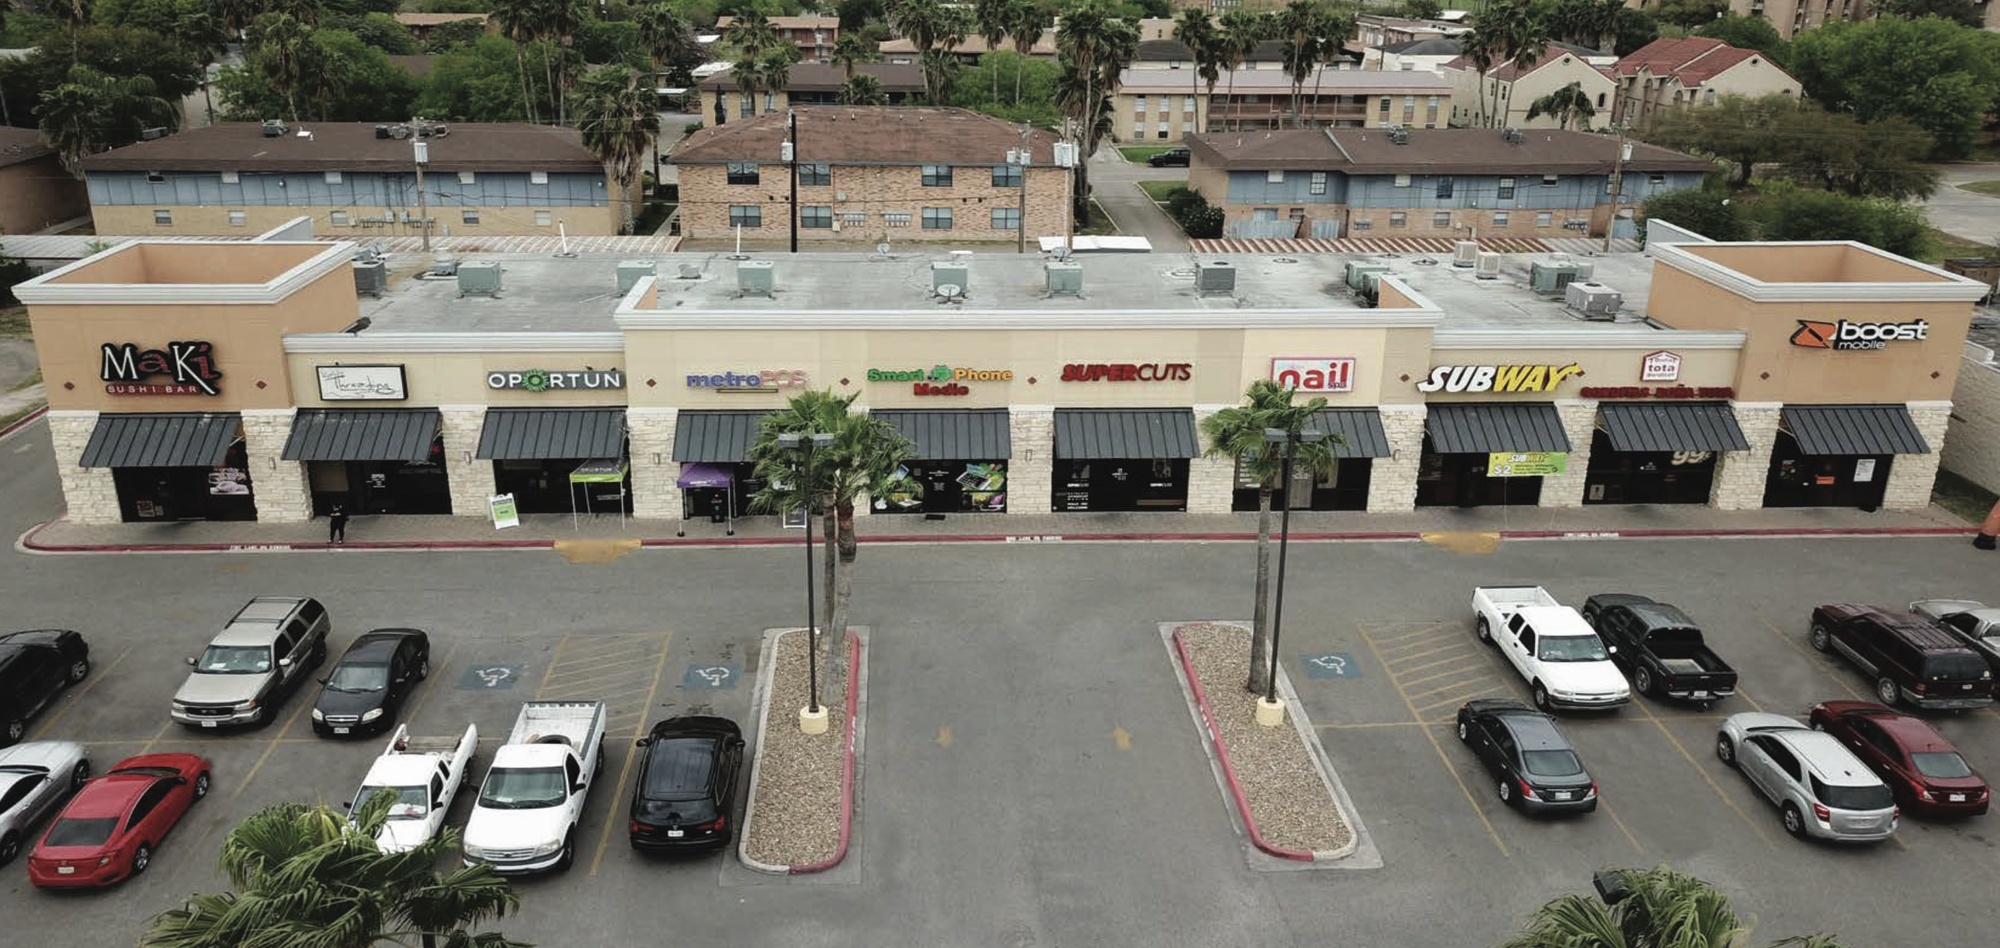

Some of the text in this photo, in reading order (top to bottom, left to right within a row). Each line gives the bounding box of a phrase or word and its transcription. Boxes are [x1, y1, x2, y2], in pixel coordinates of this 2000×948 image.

[1839, 319, 1929, 341] boost
[1838, 340, 1886, 350] mobile
[867, 368, 1014, 381] Smart Phone
[1060, 363, 1193, 382] SUPERCUTS
[1278, 361, 1349, 390] nail
[1416, 362, 1585, 393] SUBWAY
[1648, 364, 1676, 372] tota
[107, 385, 198, 394] SUSHI BAR
[488, 369, 621, 392] OPORTUN
